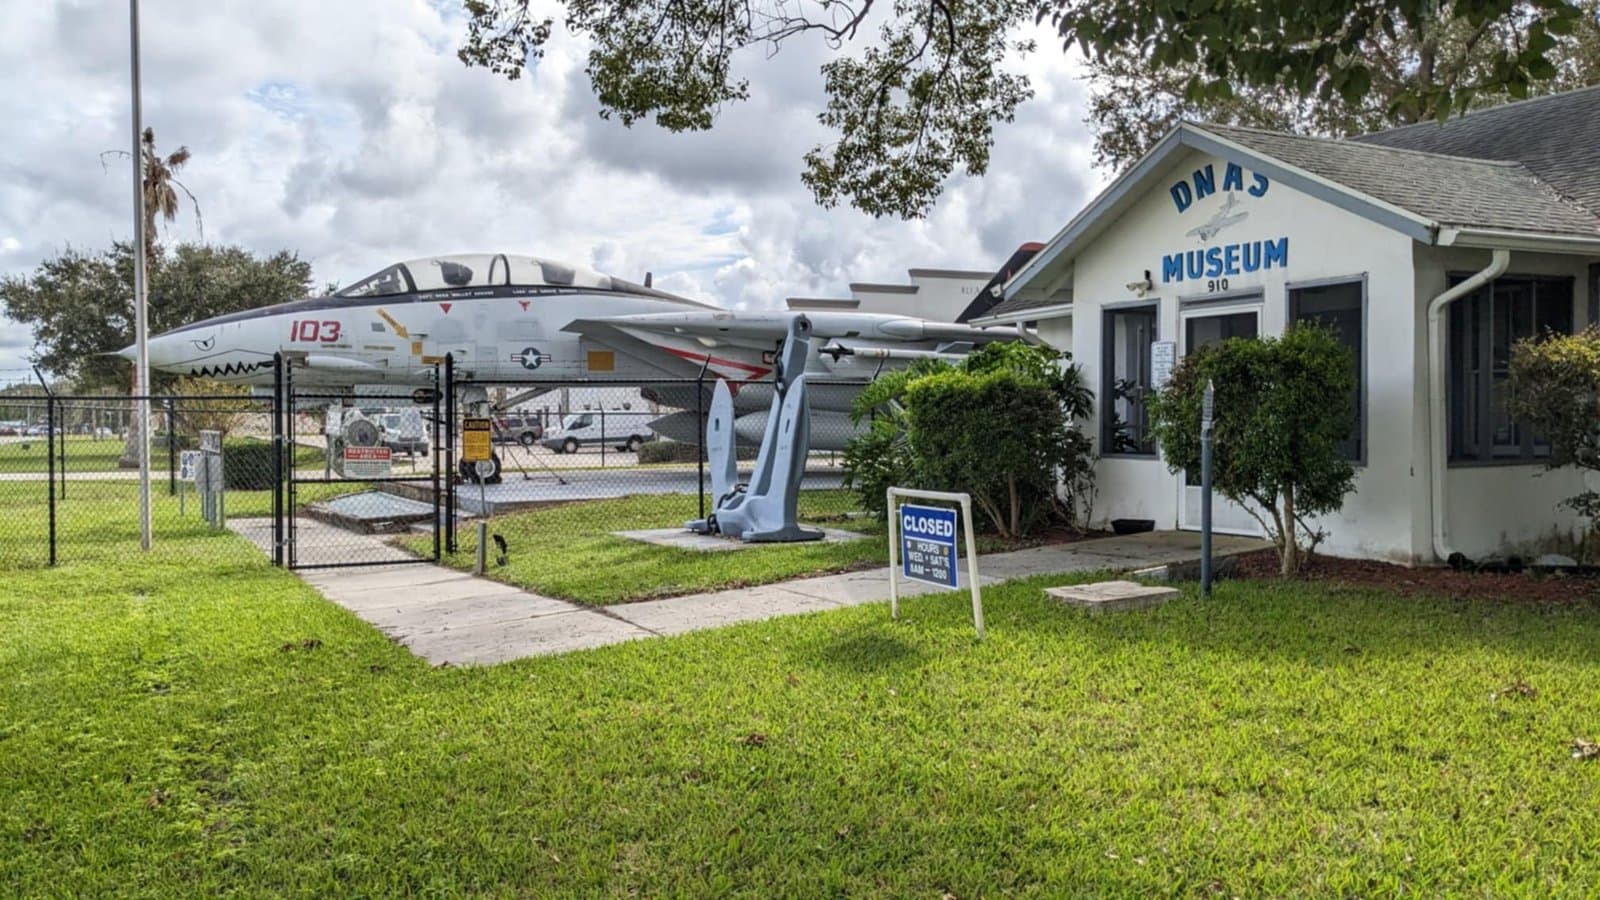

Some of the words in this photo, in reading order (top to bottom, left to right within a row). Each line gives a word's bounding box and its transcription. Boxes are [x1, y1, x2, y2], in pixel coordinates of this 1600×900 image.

[1170, 162, 1269, 213] DNAS
[1162, 236, 1289, 283] MUSEUM
[1207, 278, 1229, 293] 910
[289, 319, 341, 342] 103
[903, 515, 953, 537] CLOSED
[917, 543, 939, 554] HOURS
